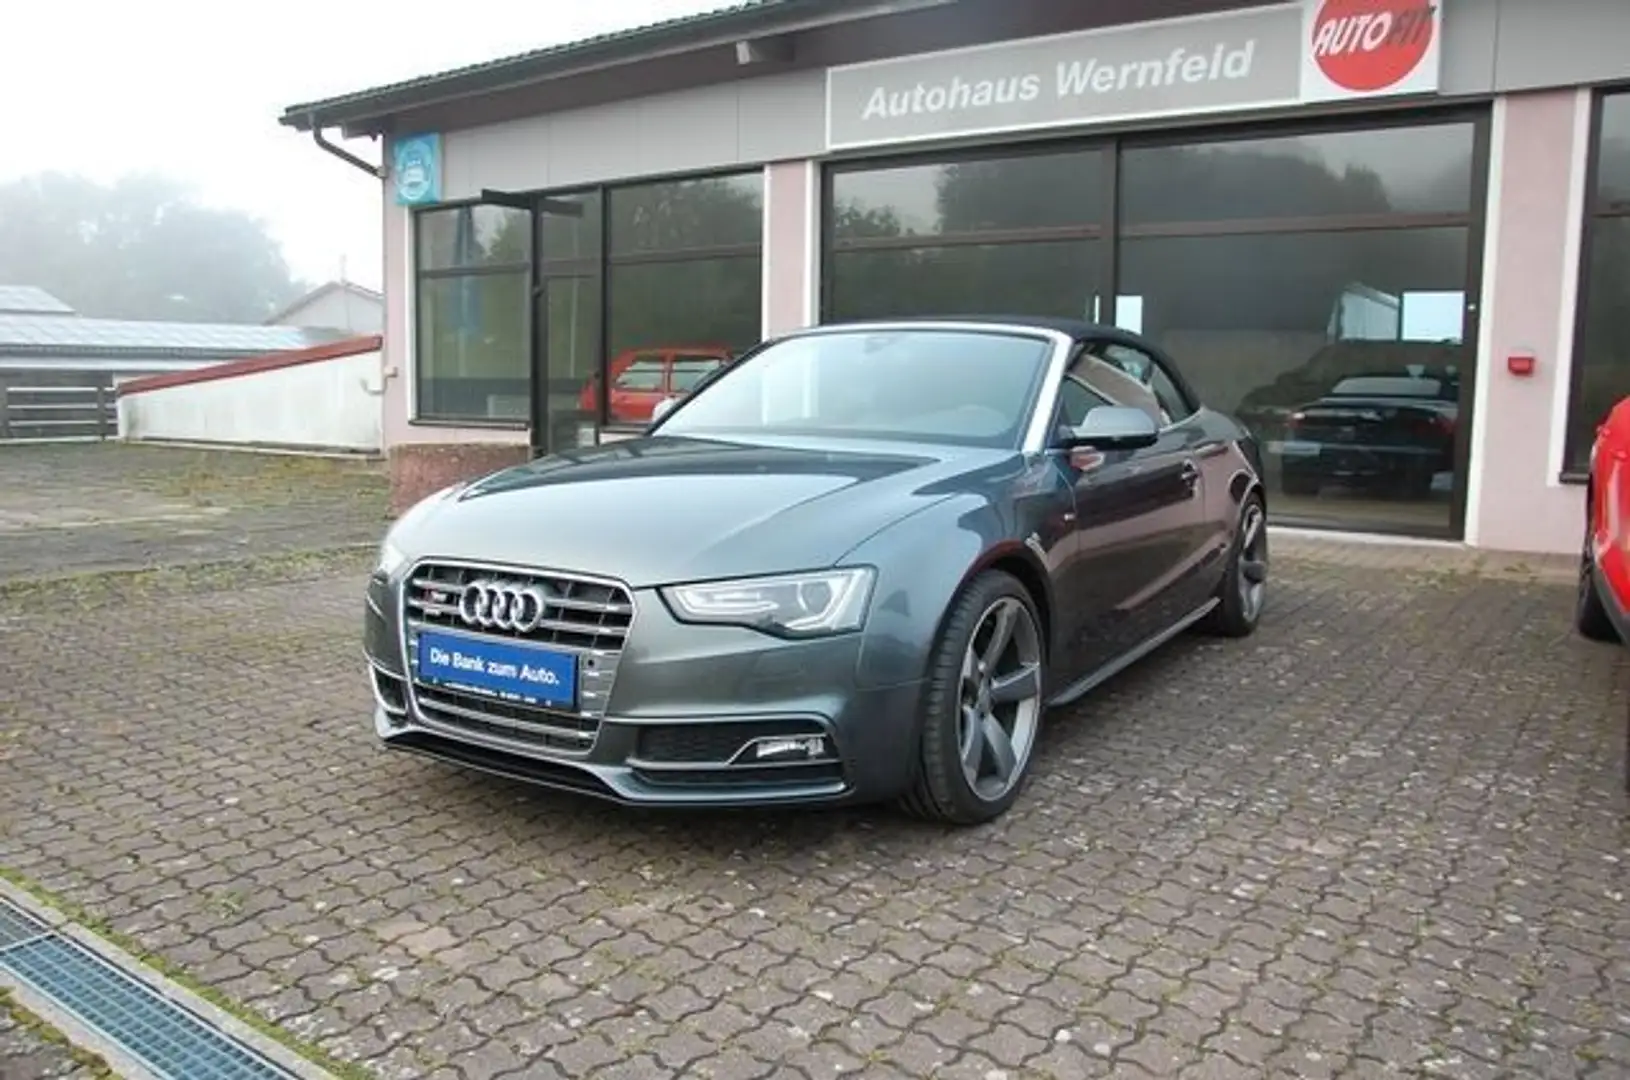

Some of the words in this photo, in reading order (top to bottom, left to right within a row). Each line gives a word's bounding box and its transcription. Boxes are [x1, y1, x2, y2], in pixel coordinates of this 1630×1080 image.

[862, 75, 1041, 120] Autohaus
[1056, 40, 1254, 96] Wernfeld
[429, 647, 450, 666] Die
[452, 651, 485, 673] Bank
[486, 661, 517, 678] zum
[519, 663, 560, 685] Auto.
